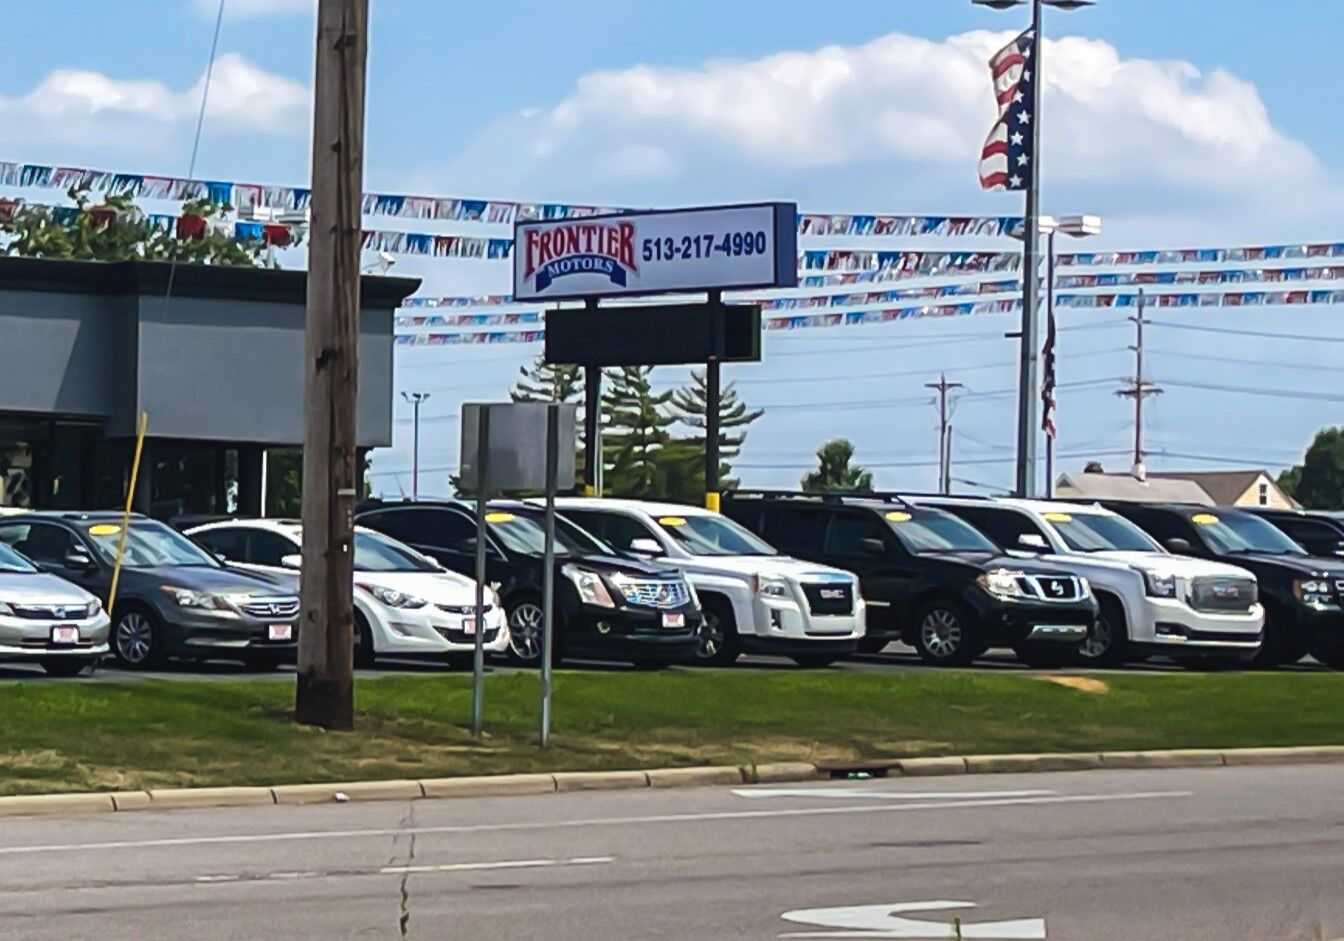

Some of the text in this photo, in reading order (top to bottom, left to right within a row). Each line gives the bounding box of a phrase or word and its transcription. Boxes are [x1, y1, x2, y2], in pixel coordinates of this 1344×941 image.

[523, 221, 638, 279] FRONTIER
[642, 231, 766, 262] 513-217-4990
[547, 257, 613, 276] MOTORS
